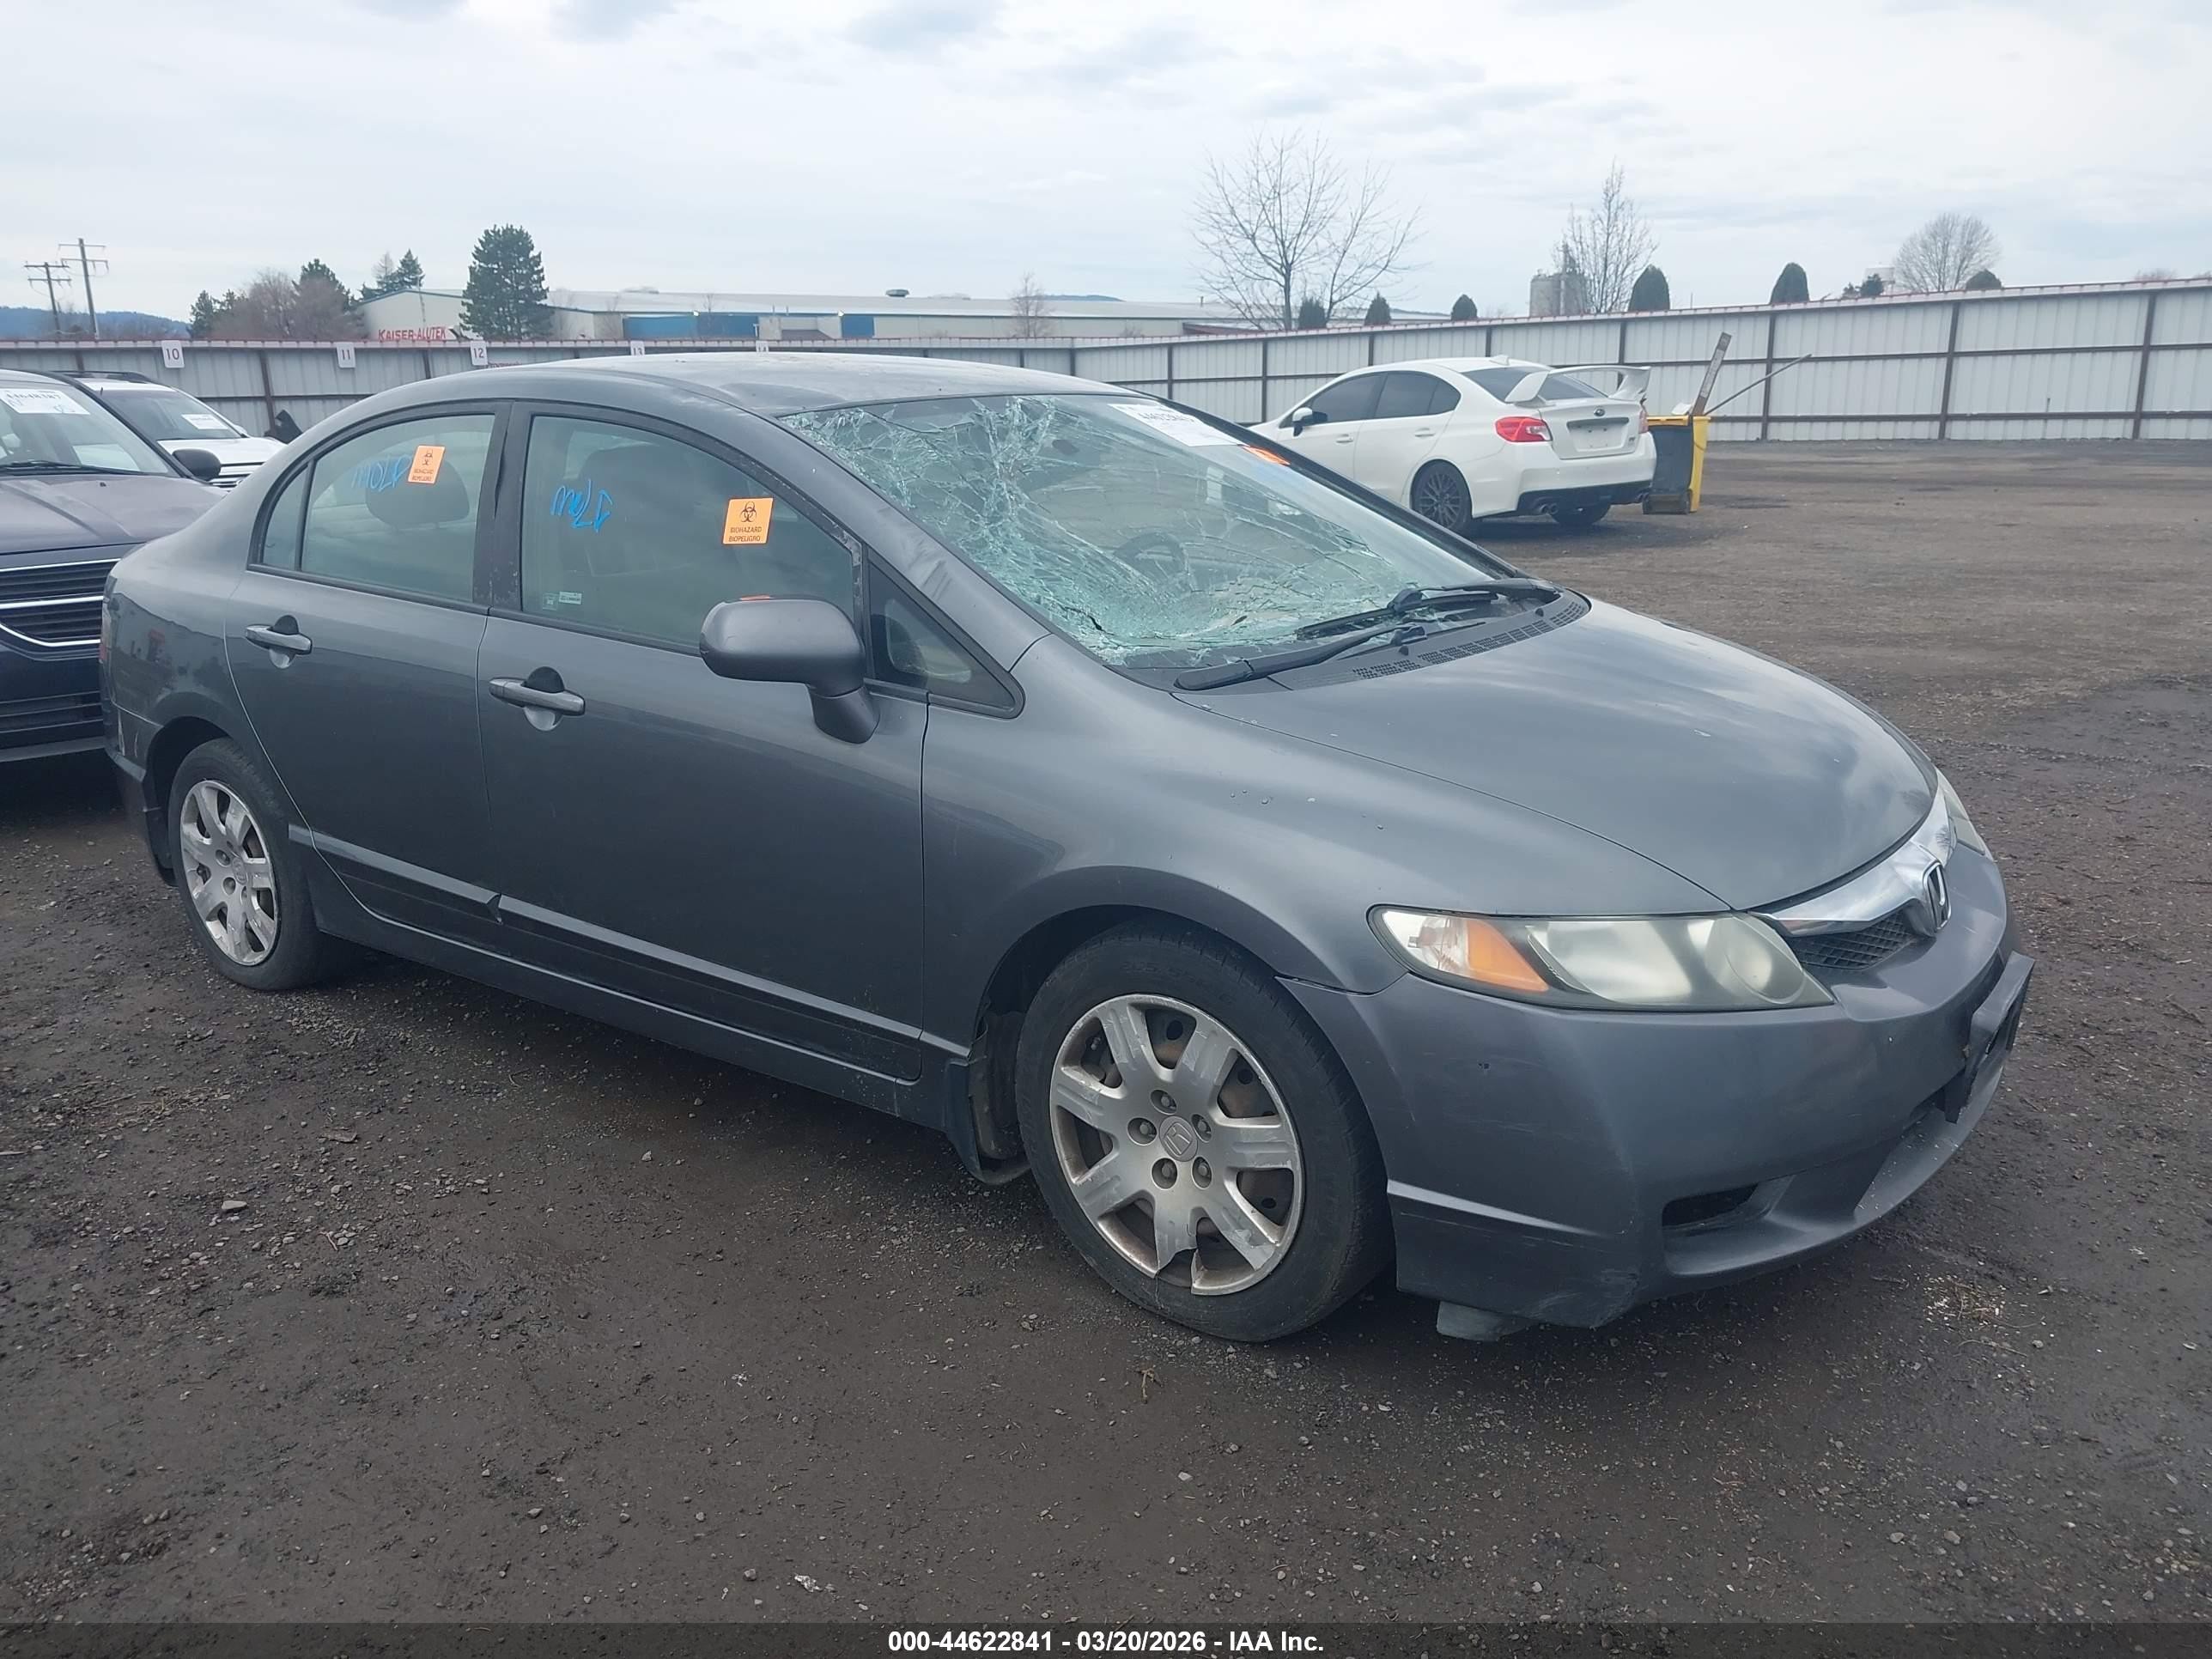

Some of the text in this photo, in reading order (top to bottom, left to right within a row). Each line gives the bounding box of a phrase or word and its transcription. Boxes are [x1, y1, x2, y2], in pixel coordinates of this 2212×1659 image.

[166, 348, 179, 361] 10
[342, 349, 351, 360] 11
[473, 347, 484, 358] 12
